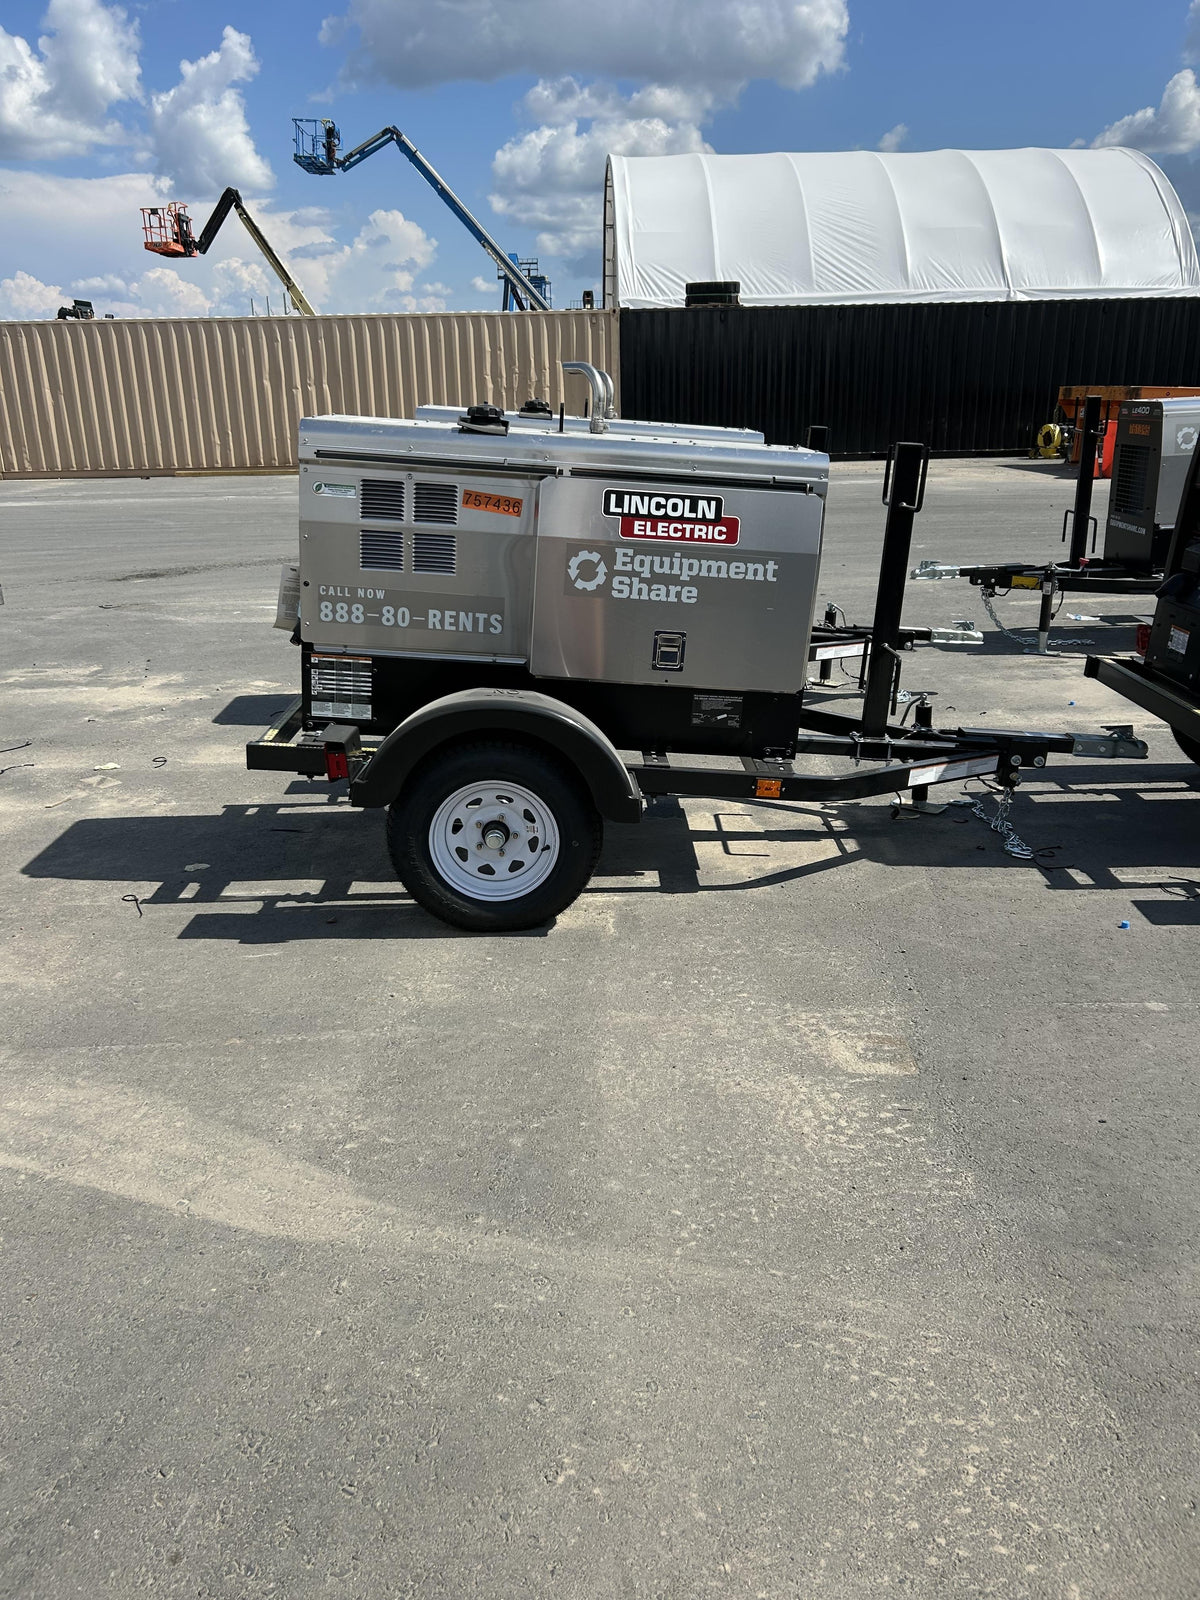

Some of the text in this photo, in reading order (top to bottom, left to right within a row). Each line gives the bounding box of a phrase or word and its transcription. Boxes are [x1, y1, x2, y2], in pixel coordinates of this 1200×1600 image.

[465, 492, 520, 515] 757436
[610, 494, 716, 519] LINCOLN
[634, 521, 727, 541] ELECTRIC
[614, 548, 778, 582] Equipment
[320, 586, 386, 600] CALL NOW
[612, 576, 697, 603] Share
[320, 602, 502, 635] 888-80-RENTS
